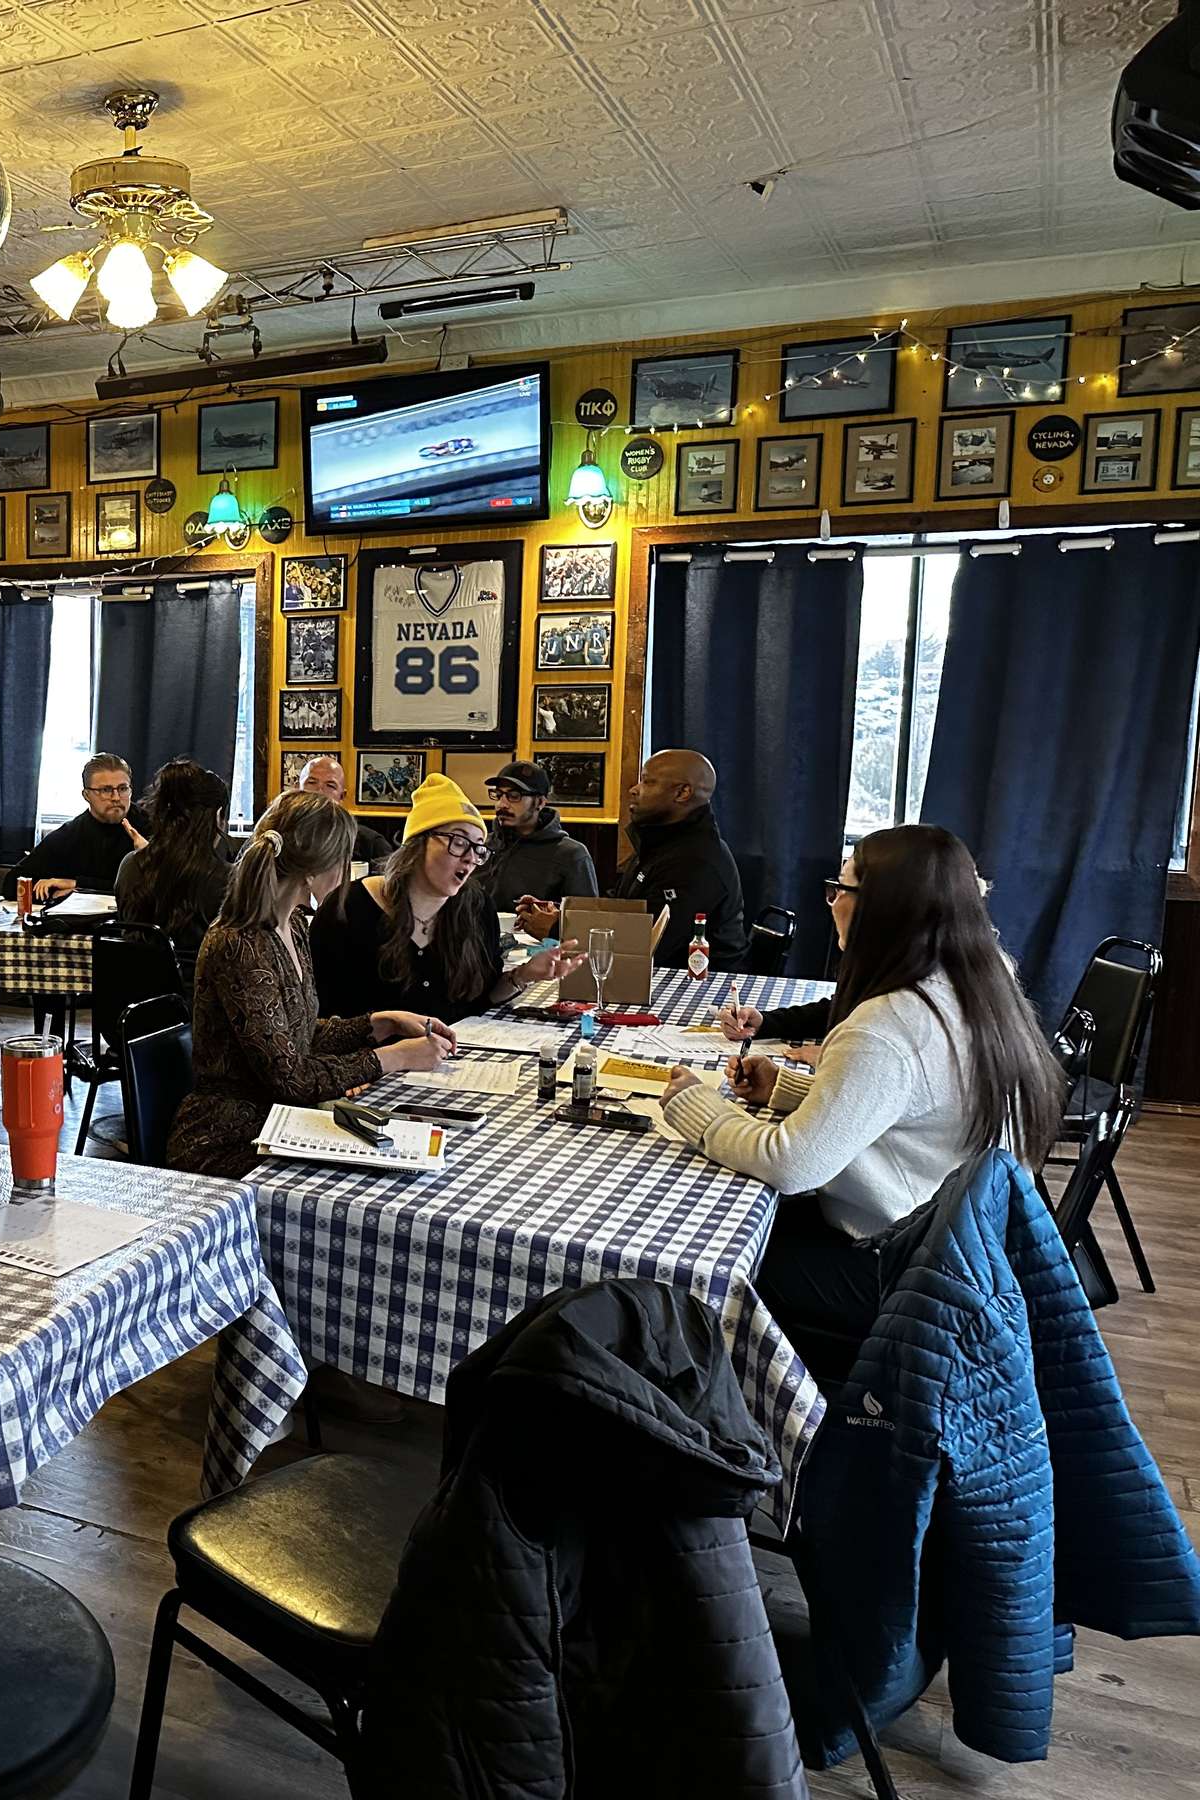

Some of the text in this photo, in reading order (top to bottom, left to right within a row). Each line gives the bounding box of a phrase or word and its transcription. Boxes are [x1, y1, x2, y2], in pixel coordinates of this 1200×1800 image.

[1035, 441, 1074, 449] NEVADA
[625, 446, 656, 457] WOMEN'S
[627, 455, 652, 465] RUGBY
[630, 465, 648, 473] CLUB
[396, 619, 479, 641] NEVADA
[394, 644, 480, 695] 86
